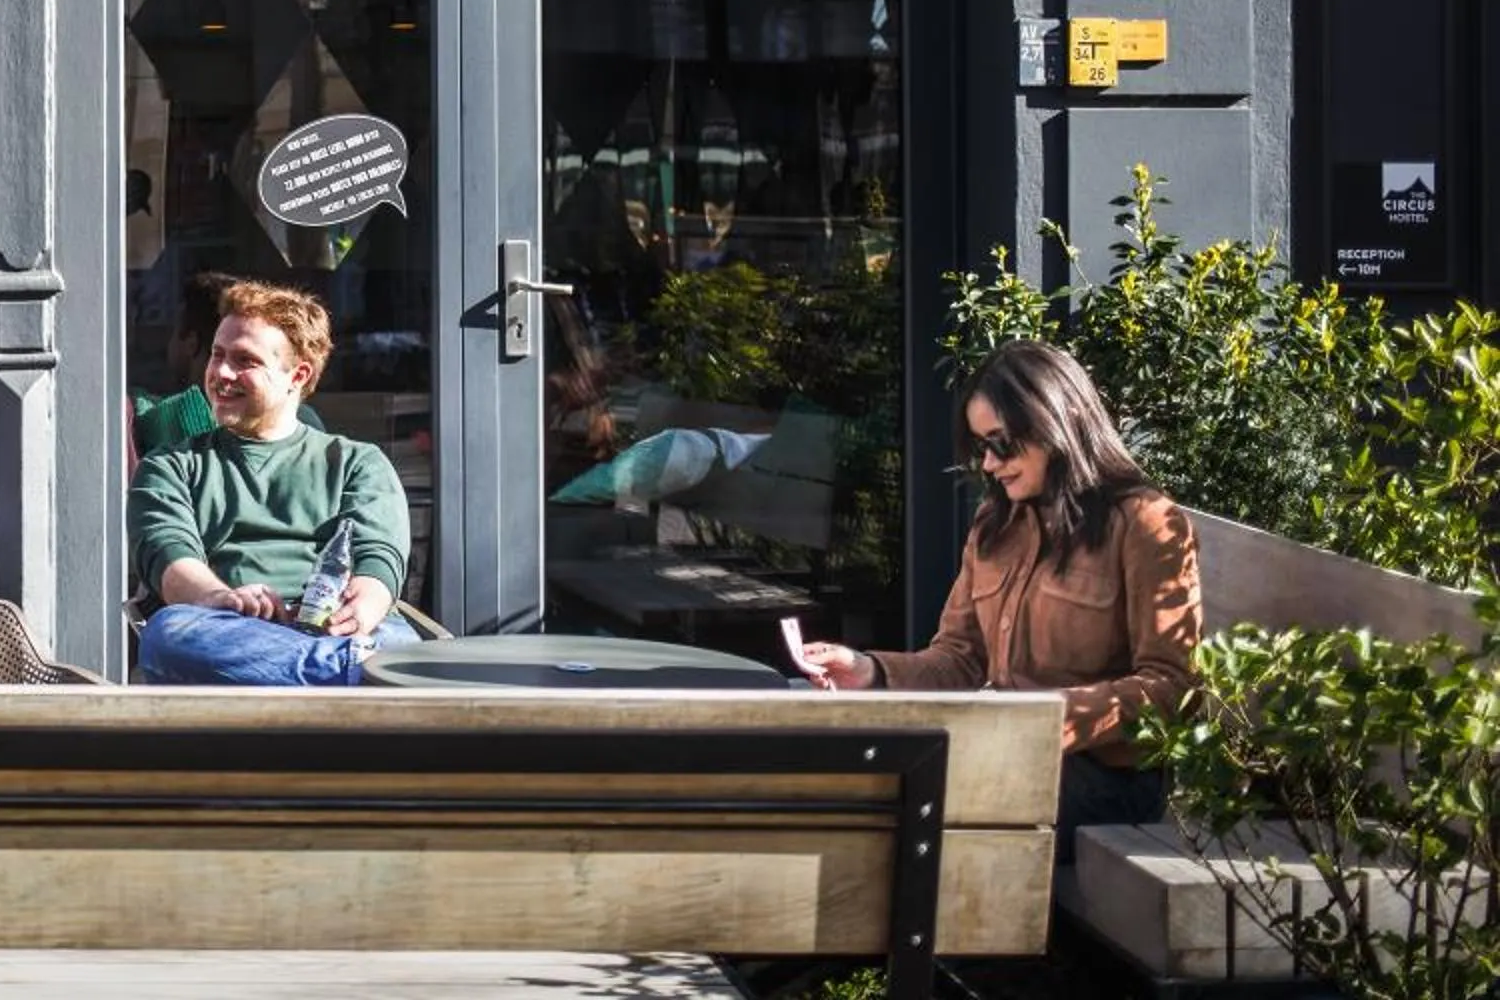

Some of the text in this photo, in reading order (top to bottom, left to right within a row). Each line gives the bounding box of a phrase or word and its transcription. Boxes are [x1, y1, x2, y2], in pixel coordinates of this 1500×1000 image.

[1383, 199, 1435, 211] CIRCUS
[1389, 214, 1429, 222] HOSTEL
[1337, 249, 1405, 260] RECEPTION
